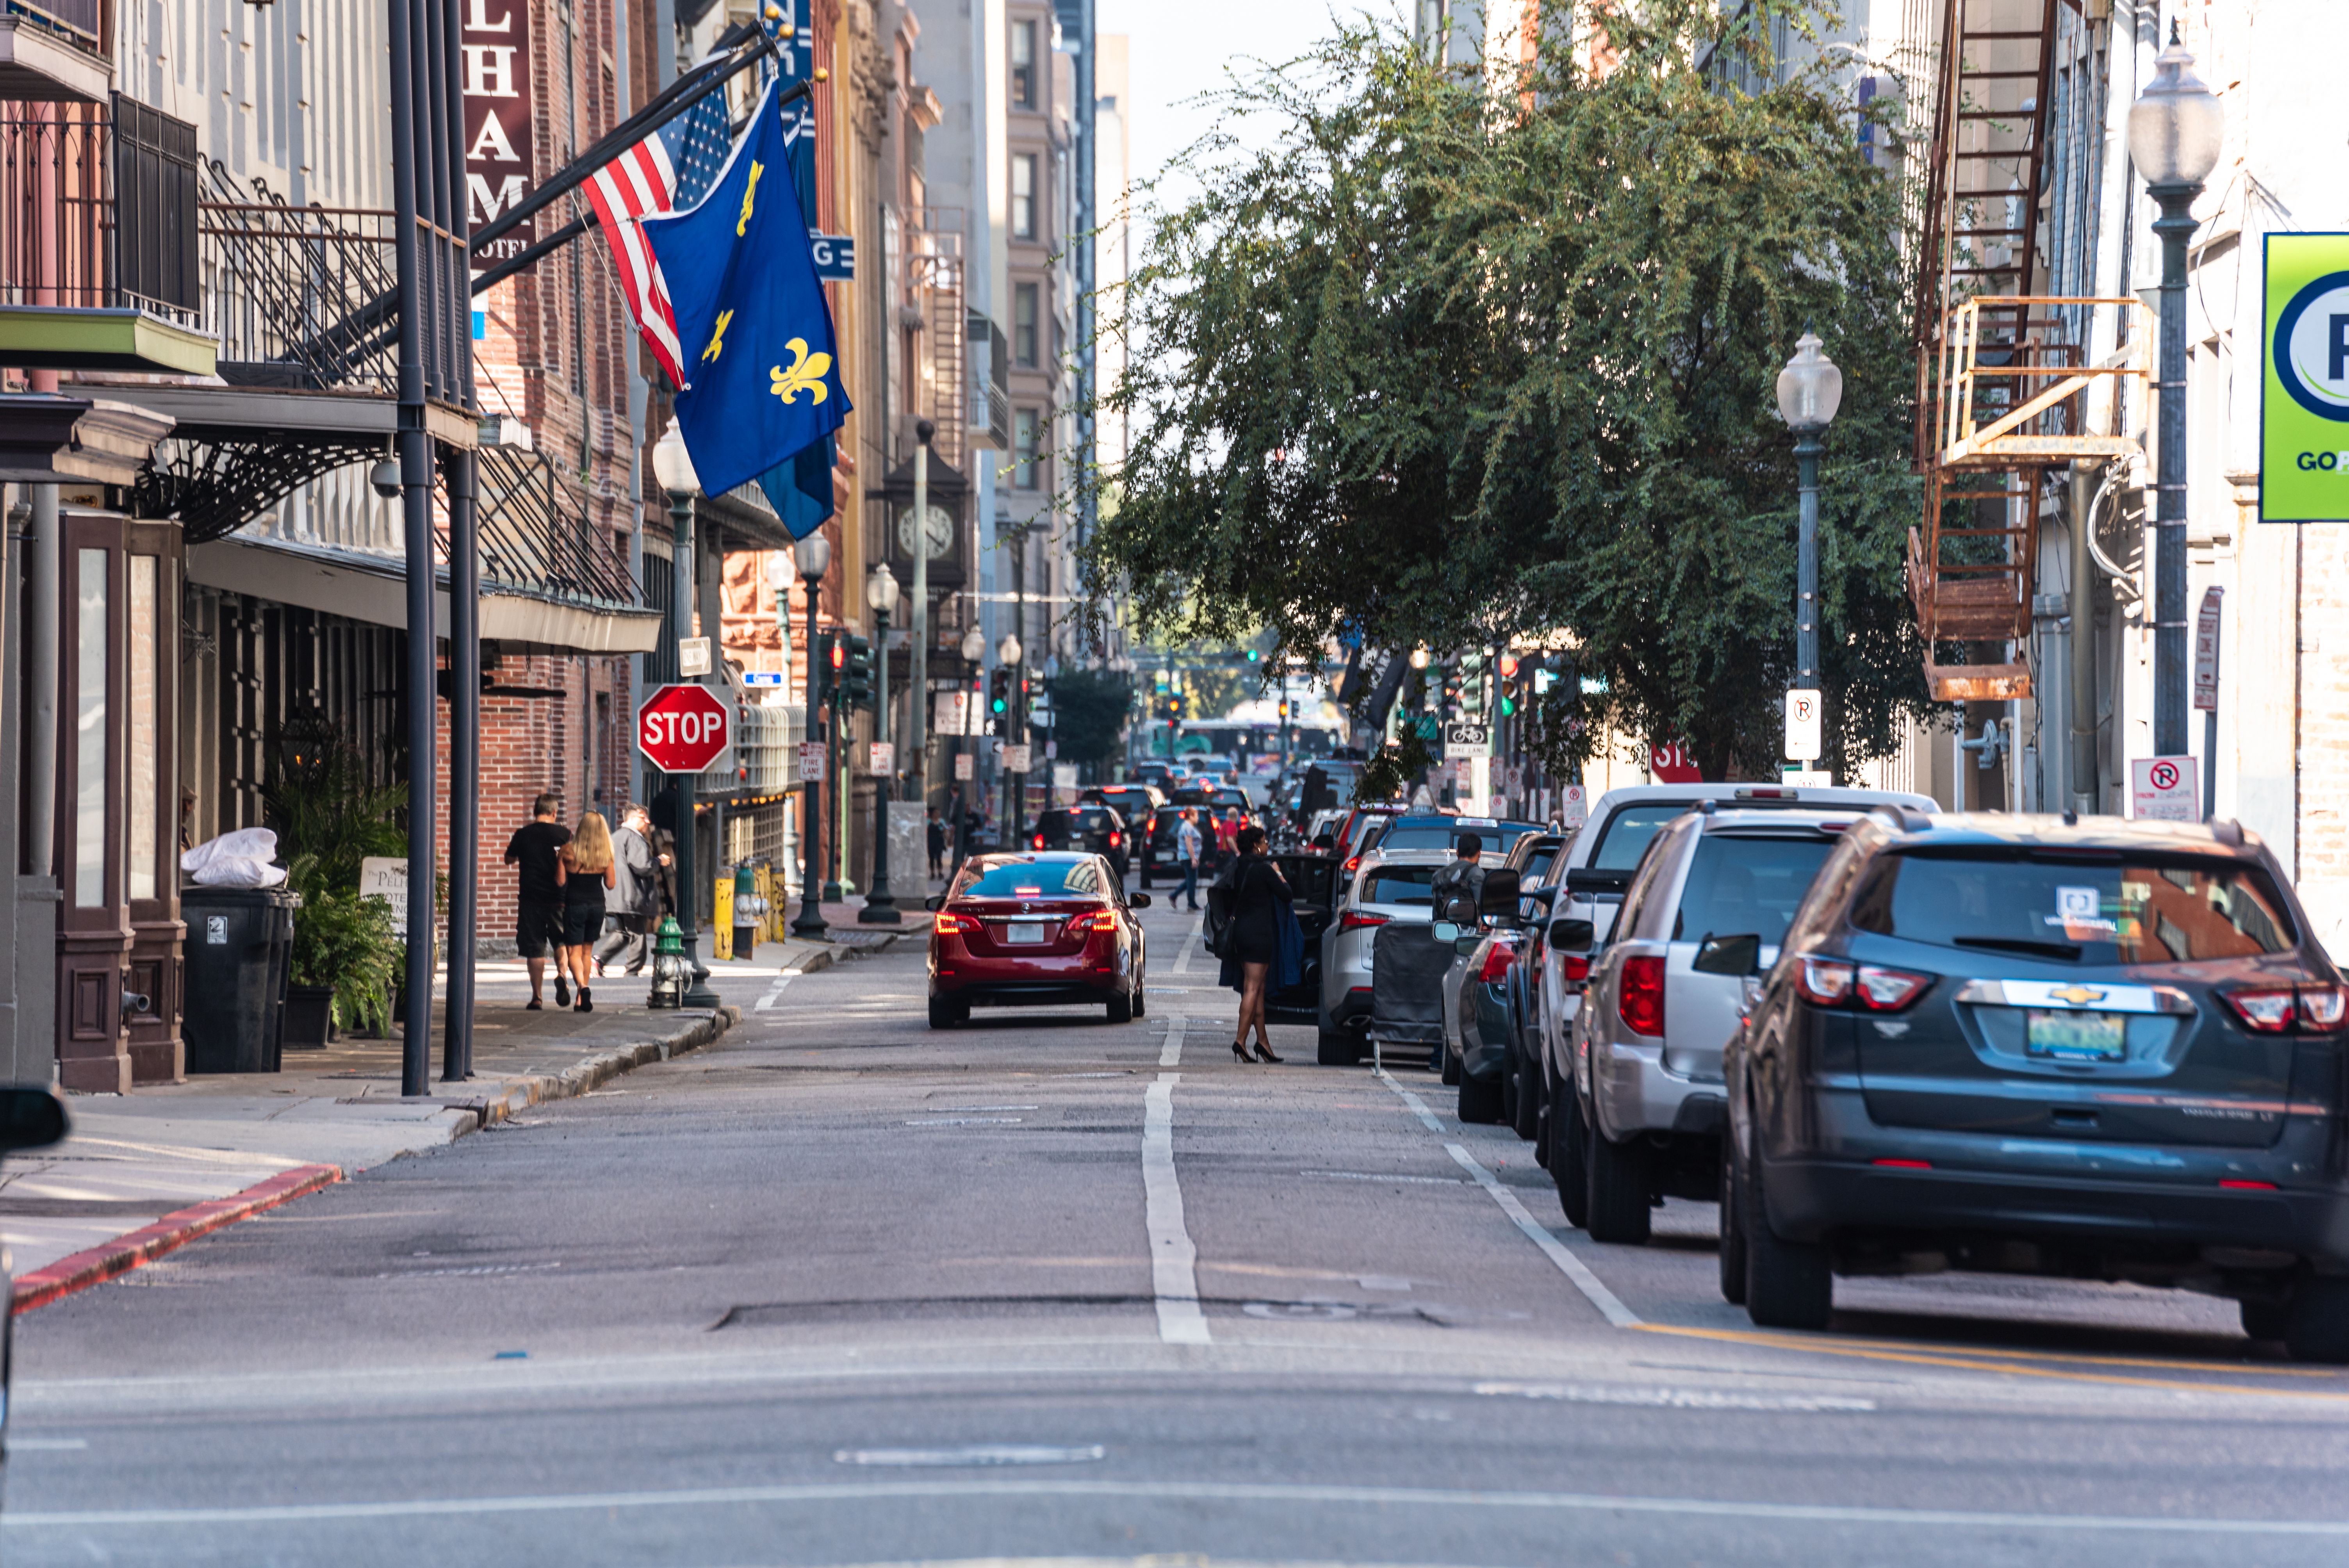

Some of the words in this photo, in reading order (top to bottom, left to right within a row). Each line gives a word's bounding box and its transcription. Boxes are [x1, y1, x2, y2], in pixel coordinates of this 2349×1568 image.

[475, 239, 528, 259] OTE
[2297, 451, 2349, 471] GOP
[645, 711, 722, 745] STOP
[378, 871, 407, 888] PELH
[385, 892, 406, 903] OTE
